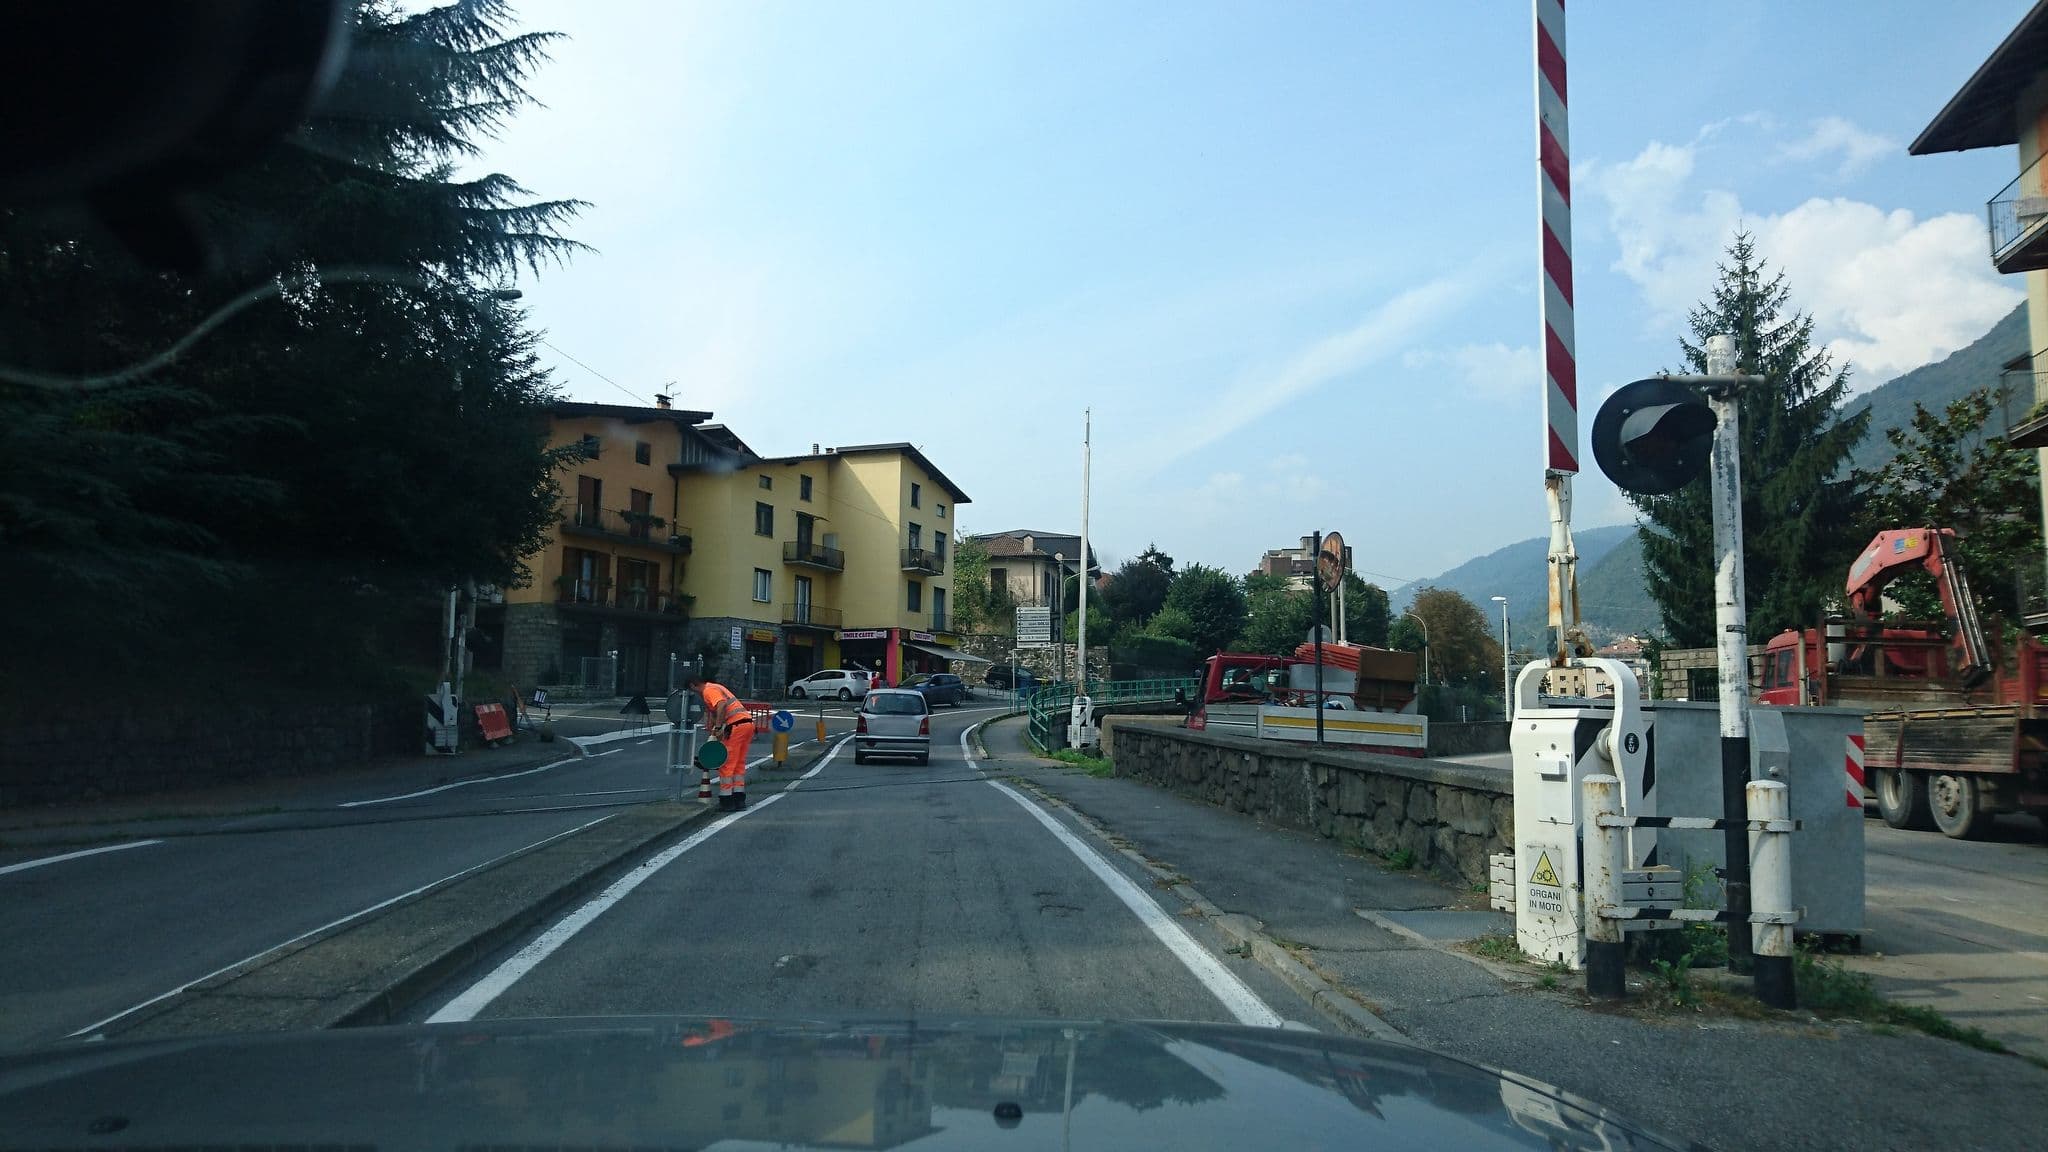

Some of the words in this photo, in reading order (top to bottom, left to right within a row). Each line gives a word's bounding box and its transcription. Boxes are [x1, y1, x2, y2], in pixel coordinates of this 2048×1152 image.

[1530, 888, 1561, 901] ORGANI
[1530, 900, 1537, 908] IN
[1539, 901, 1562, 912] MOTO
